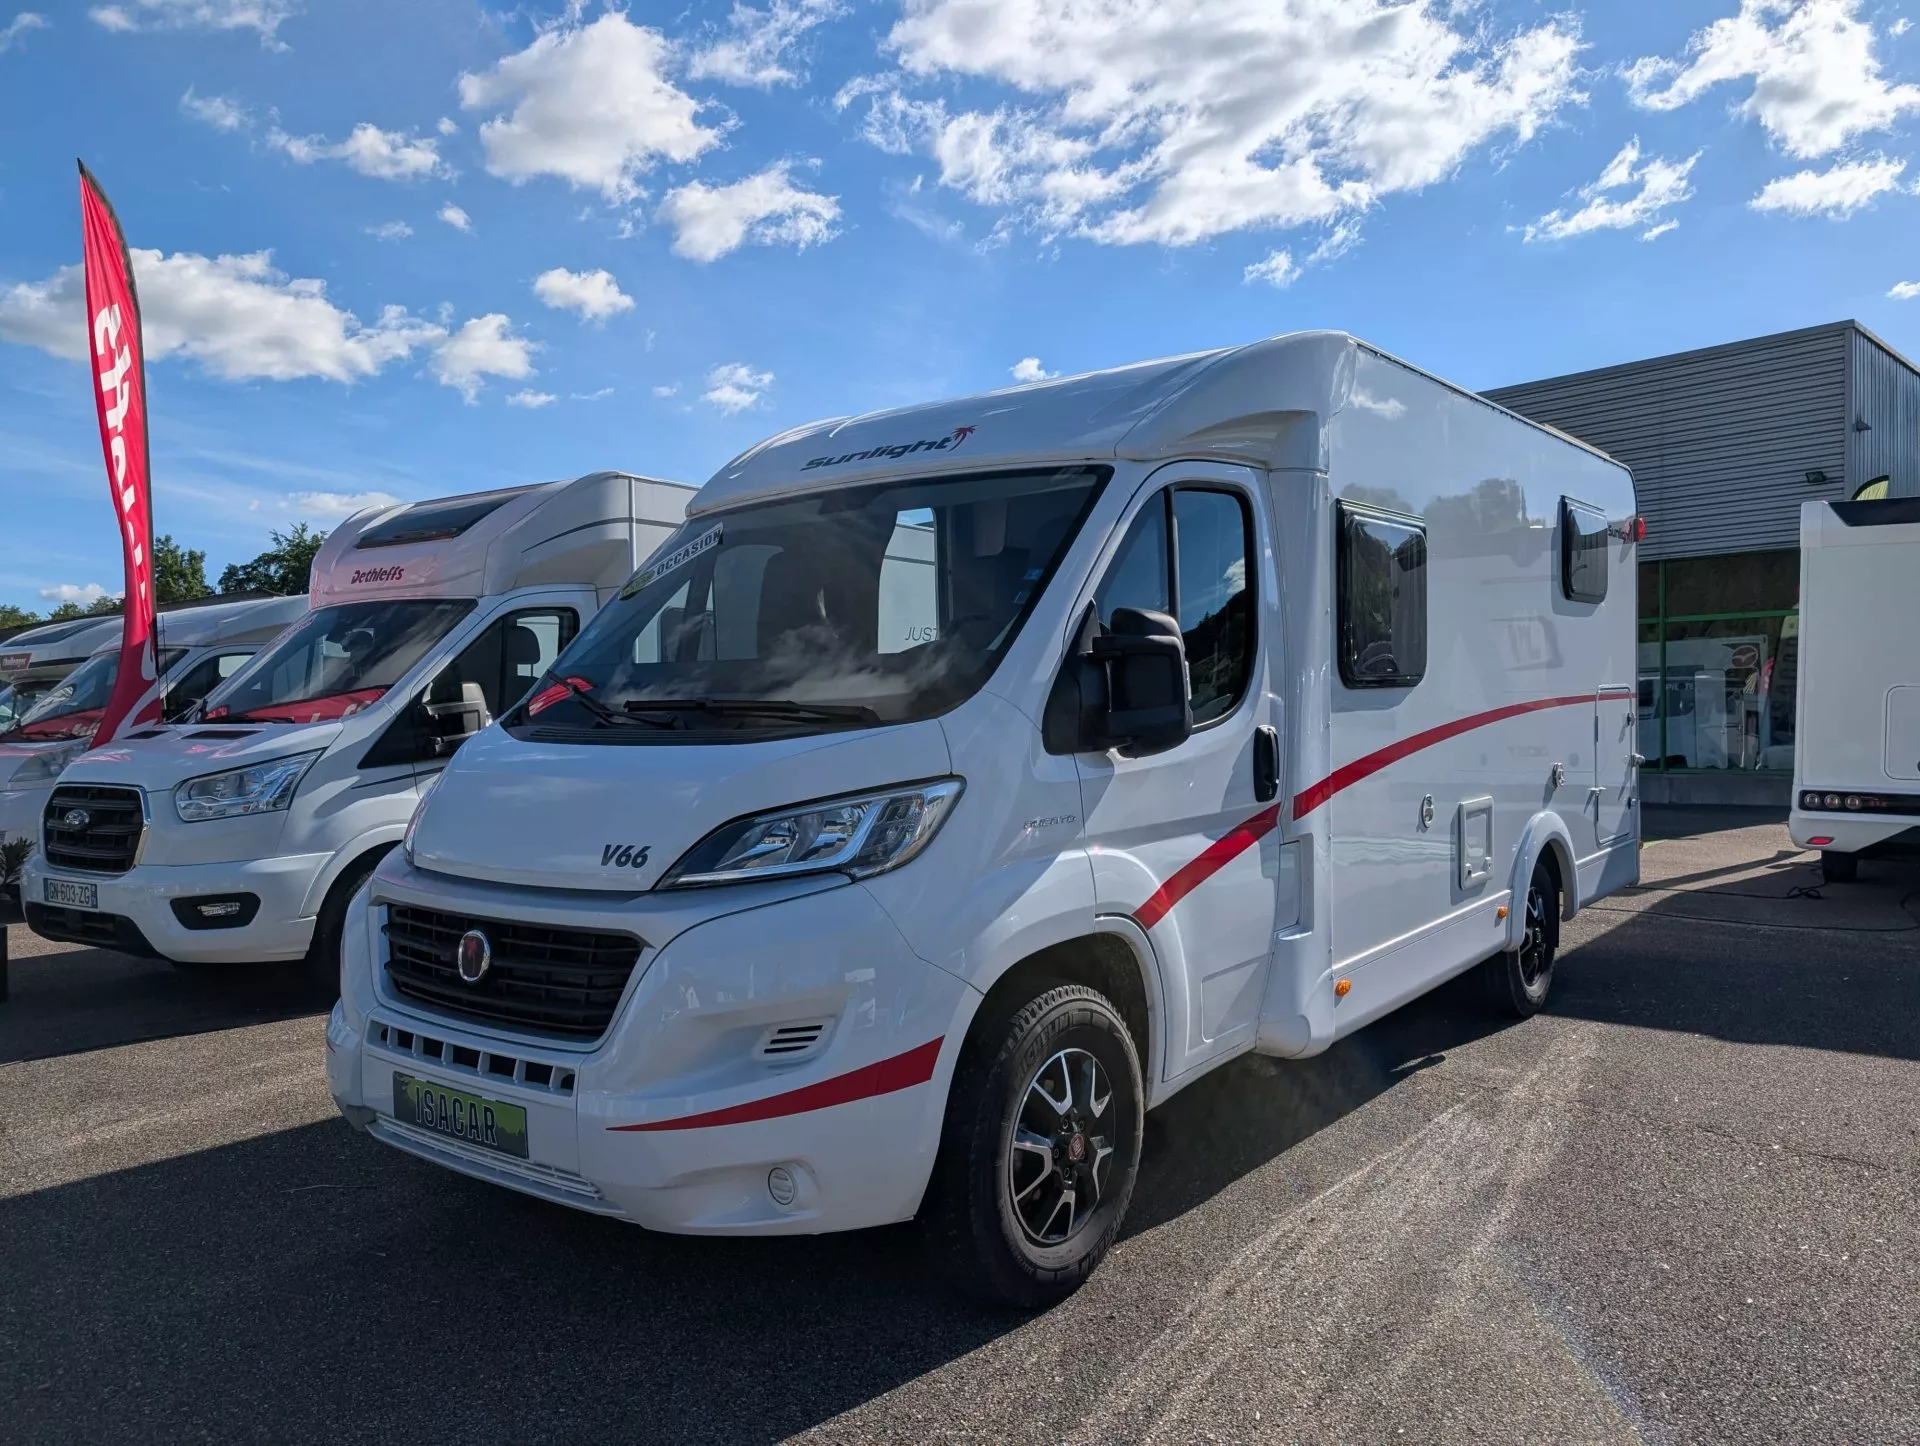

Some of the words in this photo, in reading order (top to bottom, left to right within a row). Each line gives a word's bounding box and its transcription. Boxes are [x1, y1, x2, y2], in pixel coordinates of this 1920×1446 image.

[800, 436, 952, 472] Sunlight
[656, 528, 722, 576] OCCASION
[350, 565, 404, 585] Dethleffs
[600, 844, 652, 869] V66
[48, 881, 91, 905] GN-603-ZG
[414, 1085, 498, 1146] ISACAR
